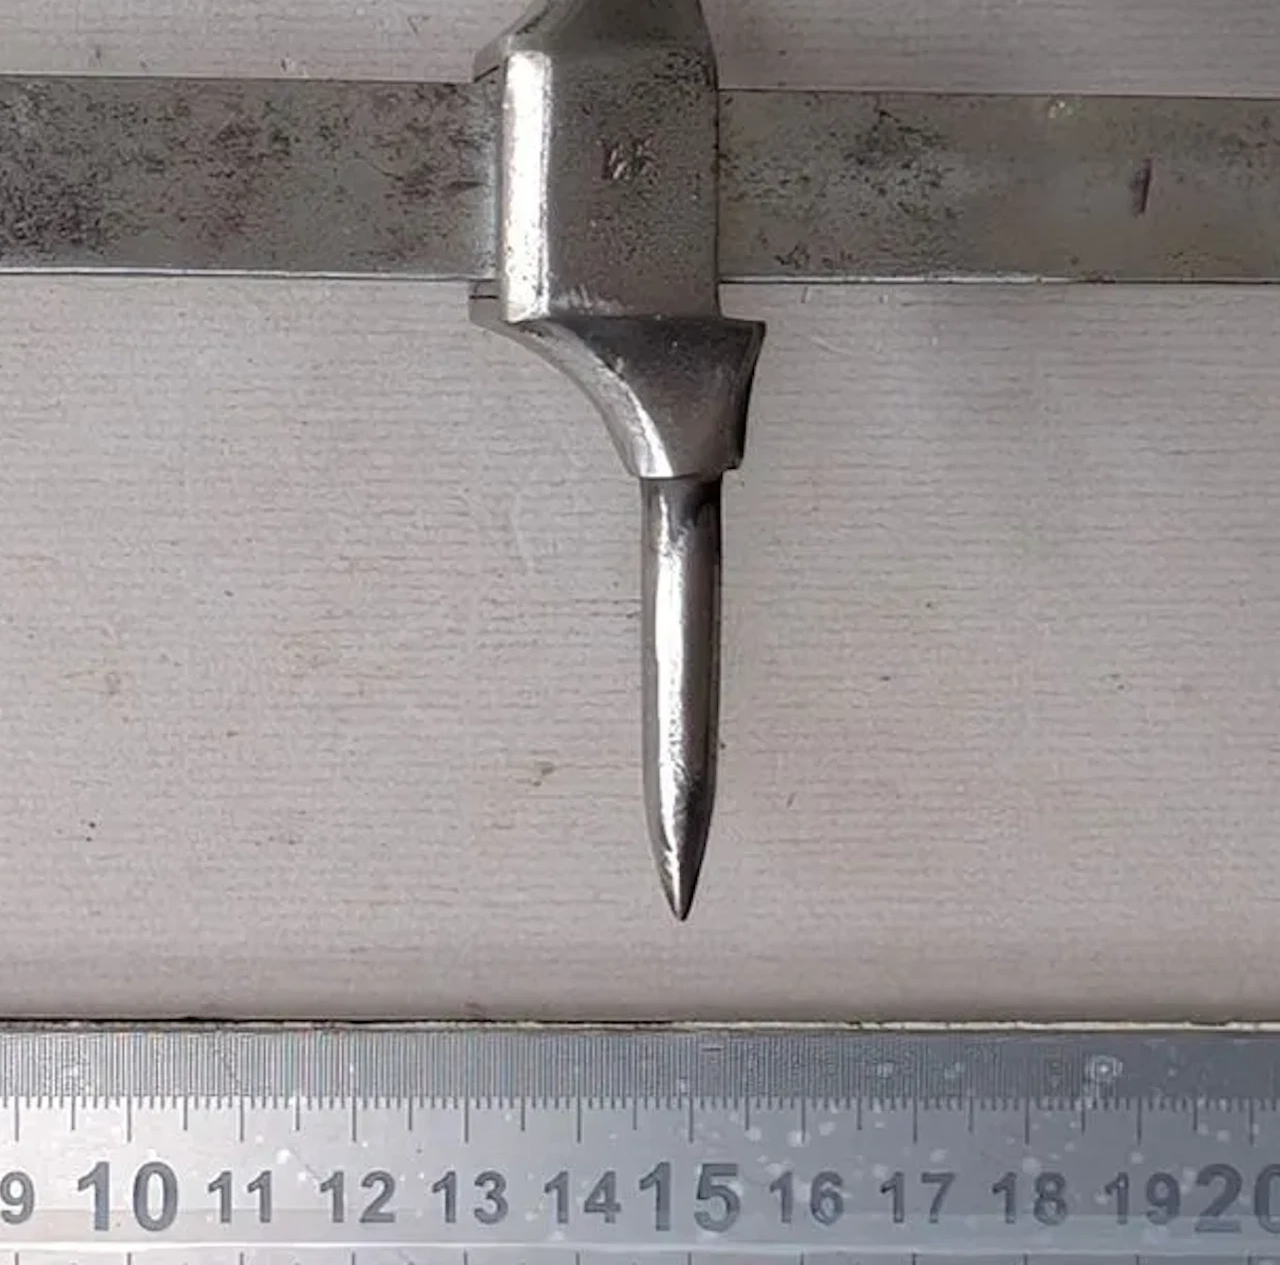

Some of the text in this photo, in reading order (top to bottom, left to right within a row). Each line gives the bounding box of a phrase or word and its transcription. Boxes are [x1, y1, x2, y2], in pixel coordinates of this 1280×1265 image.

[0, 1171, 35, 1225] 9
[77, 1161, 178, 1232] 10
[208, 1171, 271, 1224] 11
[320, 1171, 395, 1224] 12
[432, 1171, 509, 1224] 13
[544, 1171, 621, 1224] 14
[640, 1162, 741, 1232] 15
[769, 1172, 844, 1225] 16
[880, 1172, 955, 1224] 17
[992, 1172, 1067, 1225] 18
[1104, 1172, 1181, 1225] 19
